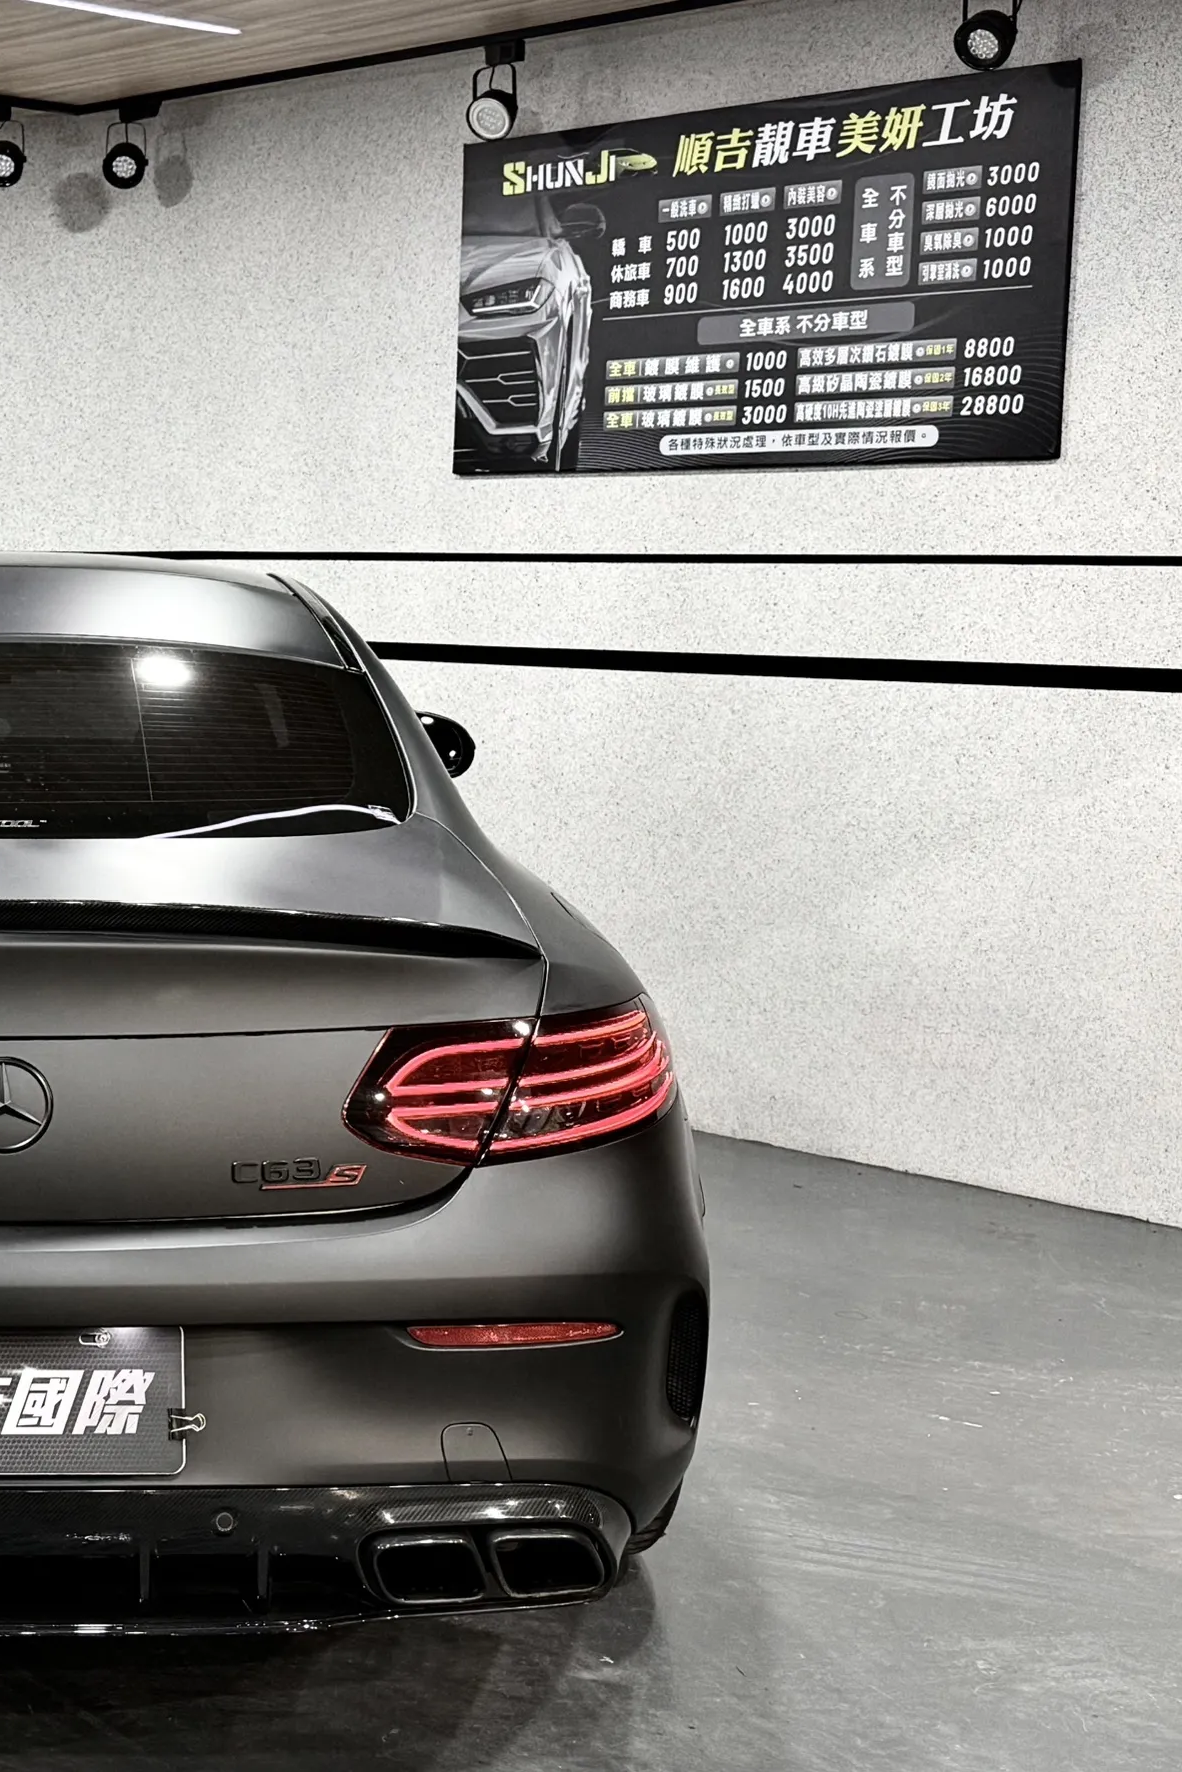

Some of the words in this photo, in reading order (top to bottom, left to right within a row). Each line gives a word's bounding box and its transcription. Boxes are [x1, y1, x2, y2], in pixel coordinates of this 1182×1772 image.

[672, 93, 1018, 178] 順吉靚車美妍工坊
[502, 150, 616, 196] SHUNJI
[926, 170, 966, 191] 鏡面拋光
[986, 161, 1040, 187] 3000
[661, 199, 697, 219] 一般洗車
[786, 184, 826, 207] 內裝美容
[925, 201, 964, 222] 深層拋光
[985, 193, 1037, 218] 6000
[666, 227, 701, 252] 500
[724, 220, 768, 246] 1000
[785, 213, 836, 240] 3000
[885, 185, 908, 278] 不分車型
[984, 224, 1034, 249] 1000
[610, 261, 652, 284] 休旅車
[666, 254, 700, 279] 700
[723, 248, 767, 274] 1300
[784, 242, 835, 268] 3500
[922, 261, 961, 283] 引擎室清洗
[983, 256, 1032, 280] 1000
[609, 288, 651, 310] 商務車
[663, 282, 699, 306] 900
[721, 276, 766, 301] 1600
[782, 269, 834, 295] 4000
[739, 316, 791, 338] 全車系
[796, 309, 868, 334] 不分車型
[608, 361, 637, 378] 全車
[644, 353, 722, 377] 鍍膜維護
[745, 350, 788, 372] 1000
[798, 342, 914, 368] 高效多層次鑽石鍍膜
[963, 336, 1015, 359] 8800
[642, 382, 704, 403] 玻璃鍍膜
[744, 378, 786, 399] 1500
[797, 370, 912, 395] 高級矽晶陶瓷鍍膜
[963, 364, 1023, 388] 16800
[606, 412, 634, 429] 全車
[641, 408, 703, 429] 玻璃鍍膜
[741, 404, 788, 426] 3000
[959, 393, 1024, 417] 28800
[231, 1157, 321, 1184] C63
